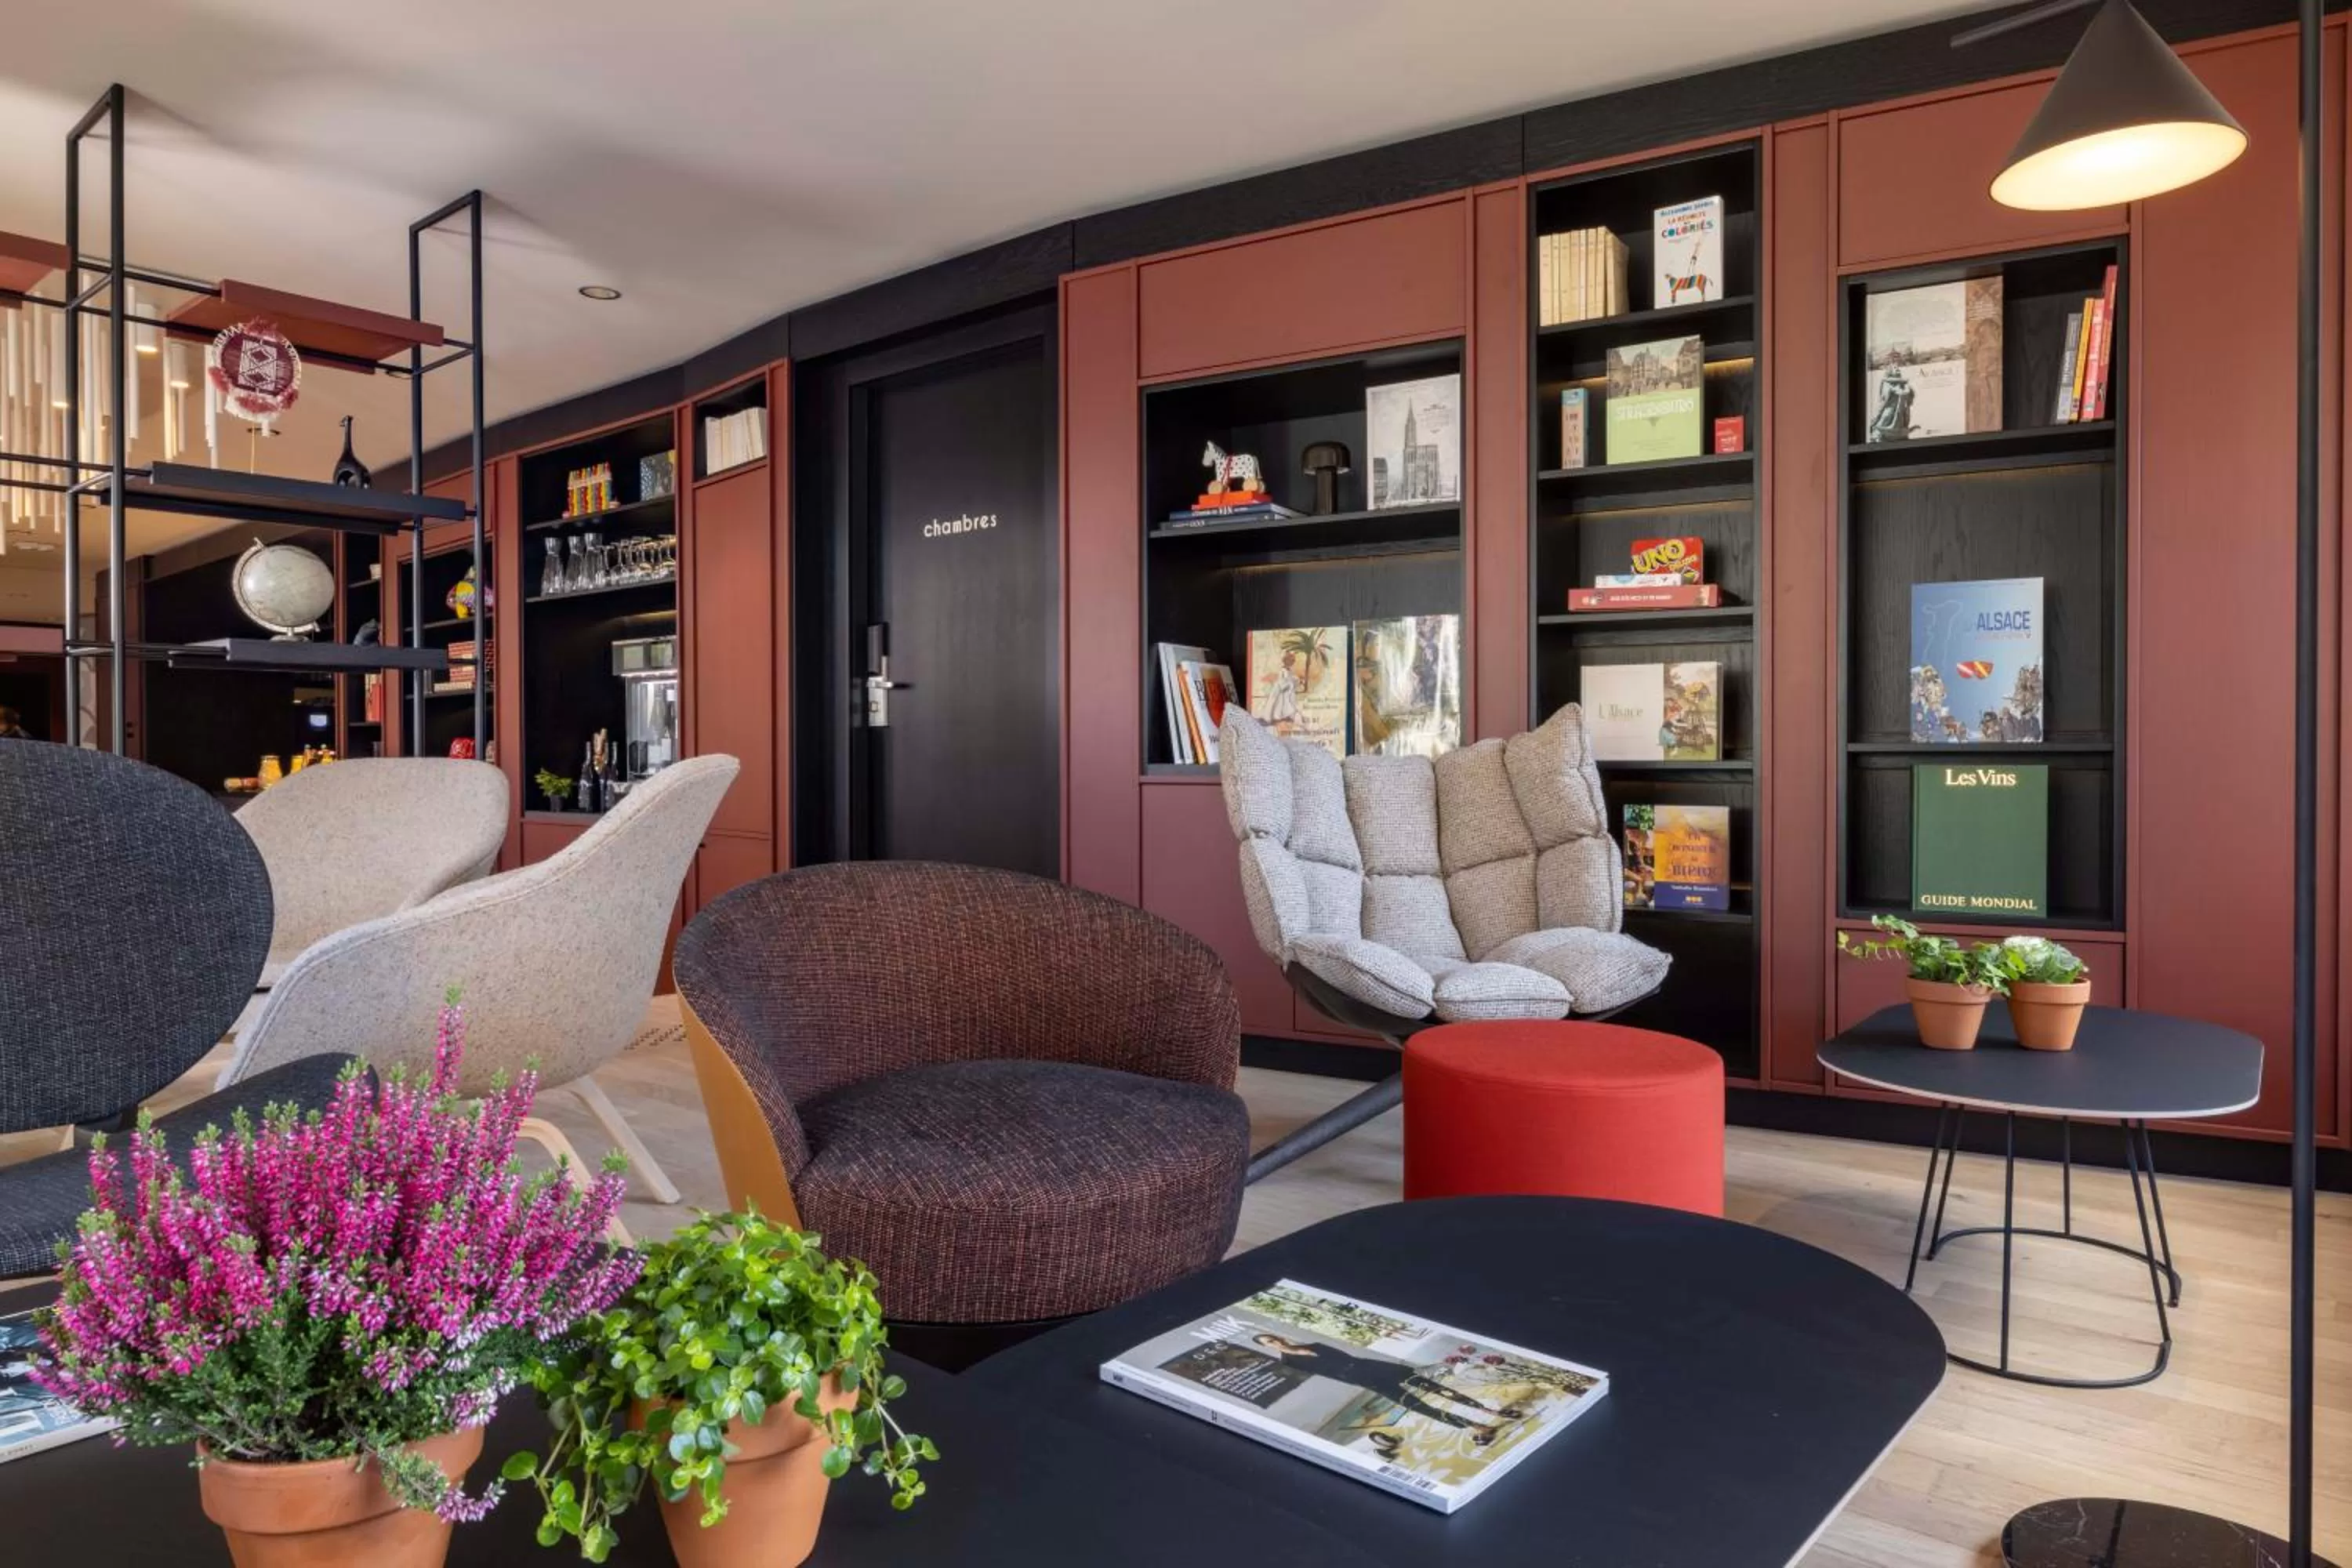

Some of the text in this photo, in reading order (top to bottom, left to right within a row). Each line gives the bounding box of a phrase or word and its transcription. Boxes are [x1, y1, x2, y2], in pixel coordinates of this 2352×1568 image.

[924, 514, 997, 537] chambres
[1631, 539, 1686, 574] UNO
[1976, 611, 2031, 631] ALSACE
[1945, 768, 2017, 786] Les Vins
[1921, 895, 2038, 910] GUIDE MONDIAL
